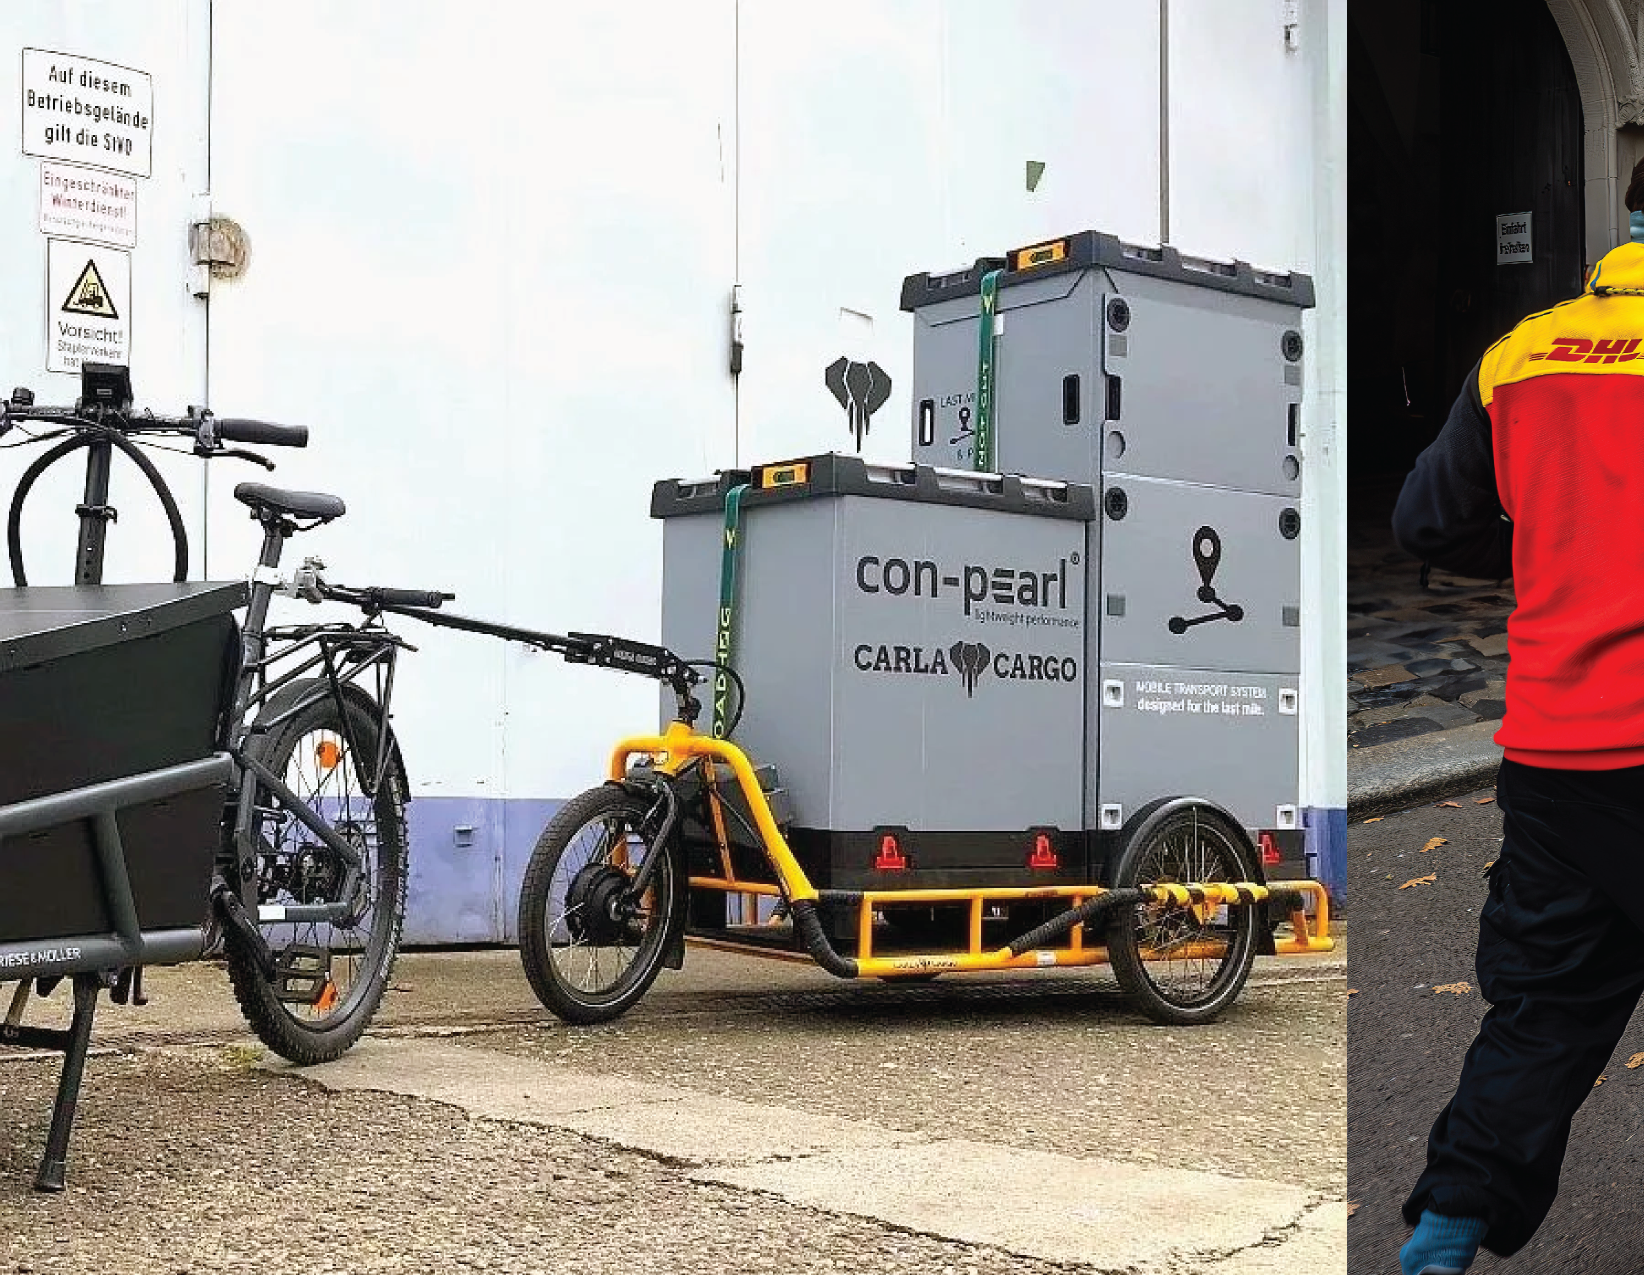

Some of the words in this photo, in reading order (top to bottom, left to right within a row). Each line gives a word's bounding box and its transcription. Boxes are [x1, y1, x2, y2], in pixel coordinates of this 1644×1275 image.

[49, 65, 73, 84] Auf
[80, 71, 132, 97] diesem
[27, 89, 149, 130] Betriebsgelände
[45, 124, 71, 145] gilt
[76, 128, 98, 147] die
[1545, 337, 1643, 365] DHL
[854, 643, 949, 676] CARLA
[993, 651, 1078, 683] CARGO
[1136, 680, 1171, 695] MOBILE
[1174, 682, 1228, 698] TRANSPORT
[1187, 699, 1202, 713] for
[1203, 699, 1219, 714] the
